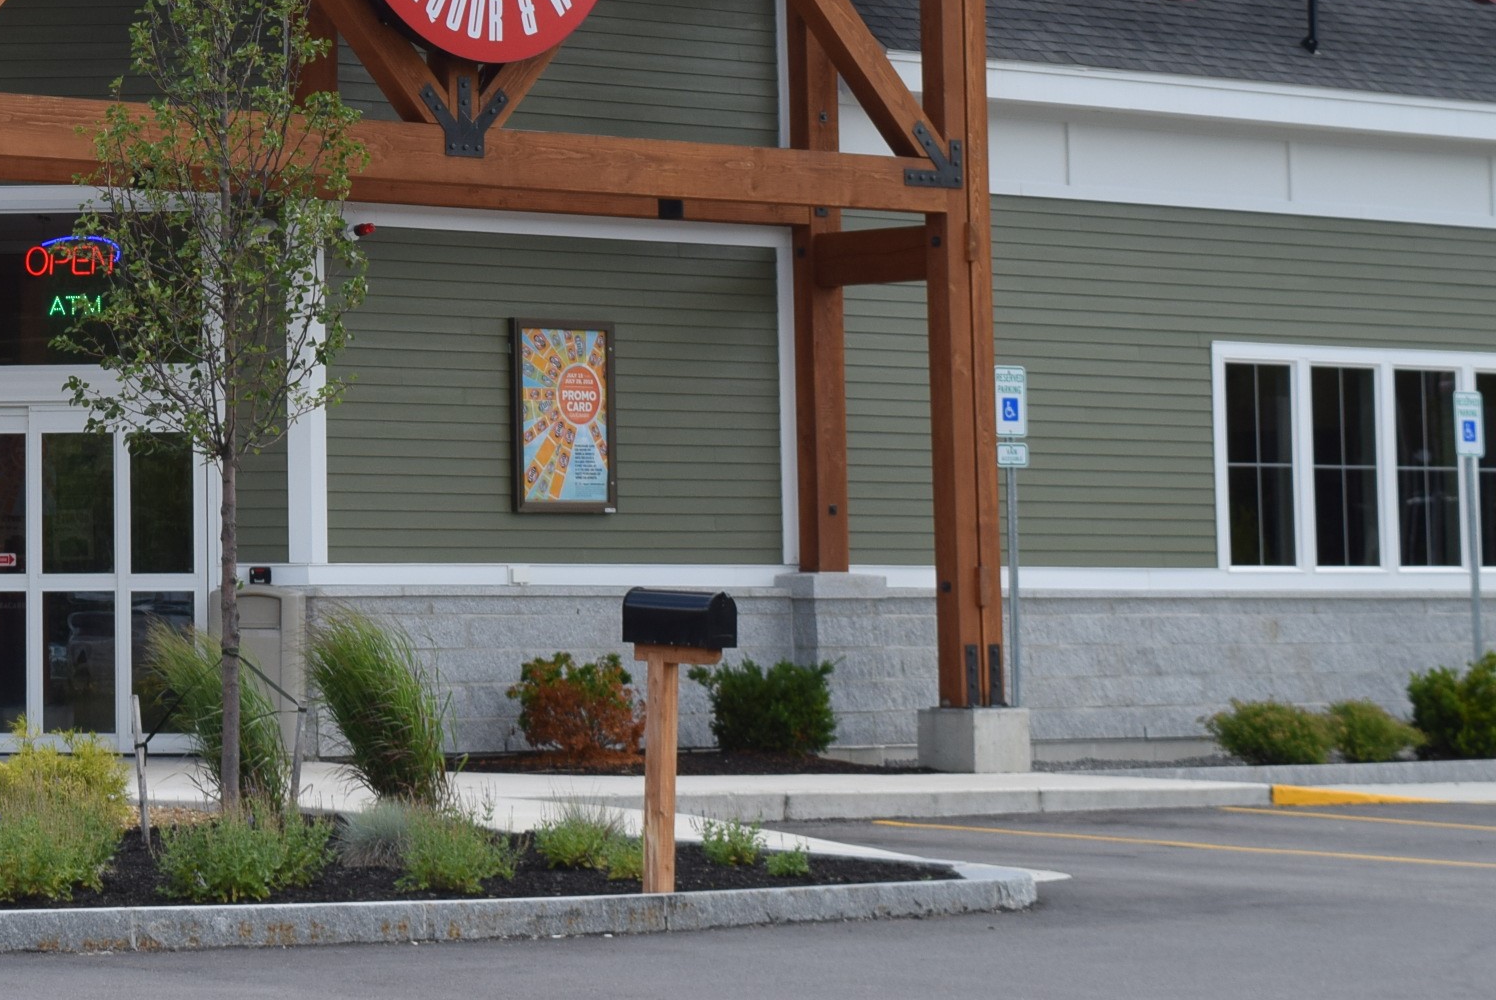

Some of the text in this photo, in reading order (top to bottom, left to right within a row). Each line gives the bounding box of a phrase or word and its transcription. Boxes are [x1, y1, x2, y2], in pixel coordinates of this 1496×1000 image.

[25, 245, 114, 277] OPEN
[49, 294, 101, 316] ATM
[996, 373, 1024, 382] RESERVED
[998, 384, 1022, 394] PARKING
[561, 389, 597, 402] PROMO
[566, 401, 593, 412] CARD
